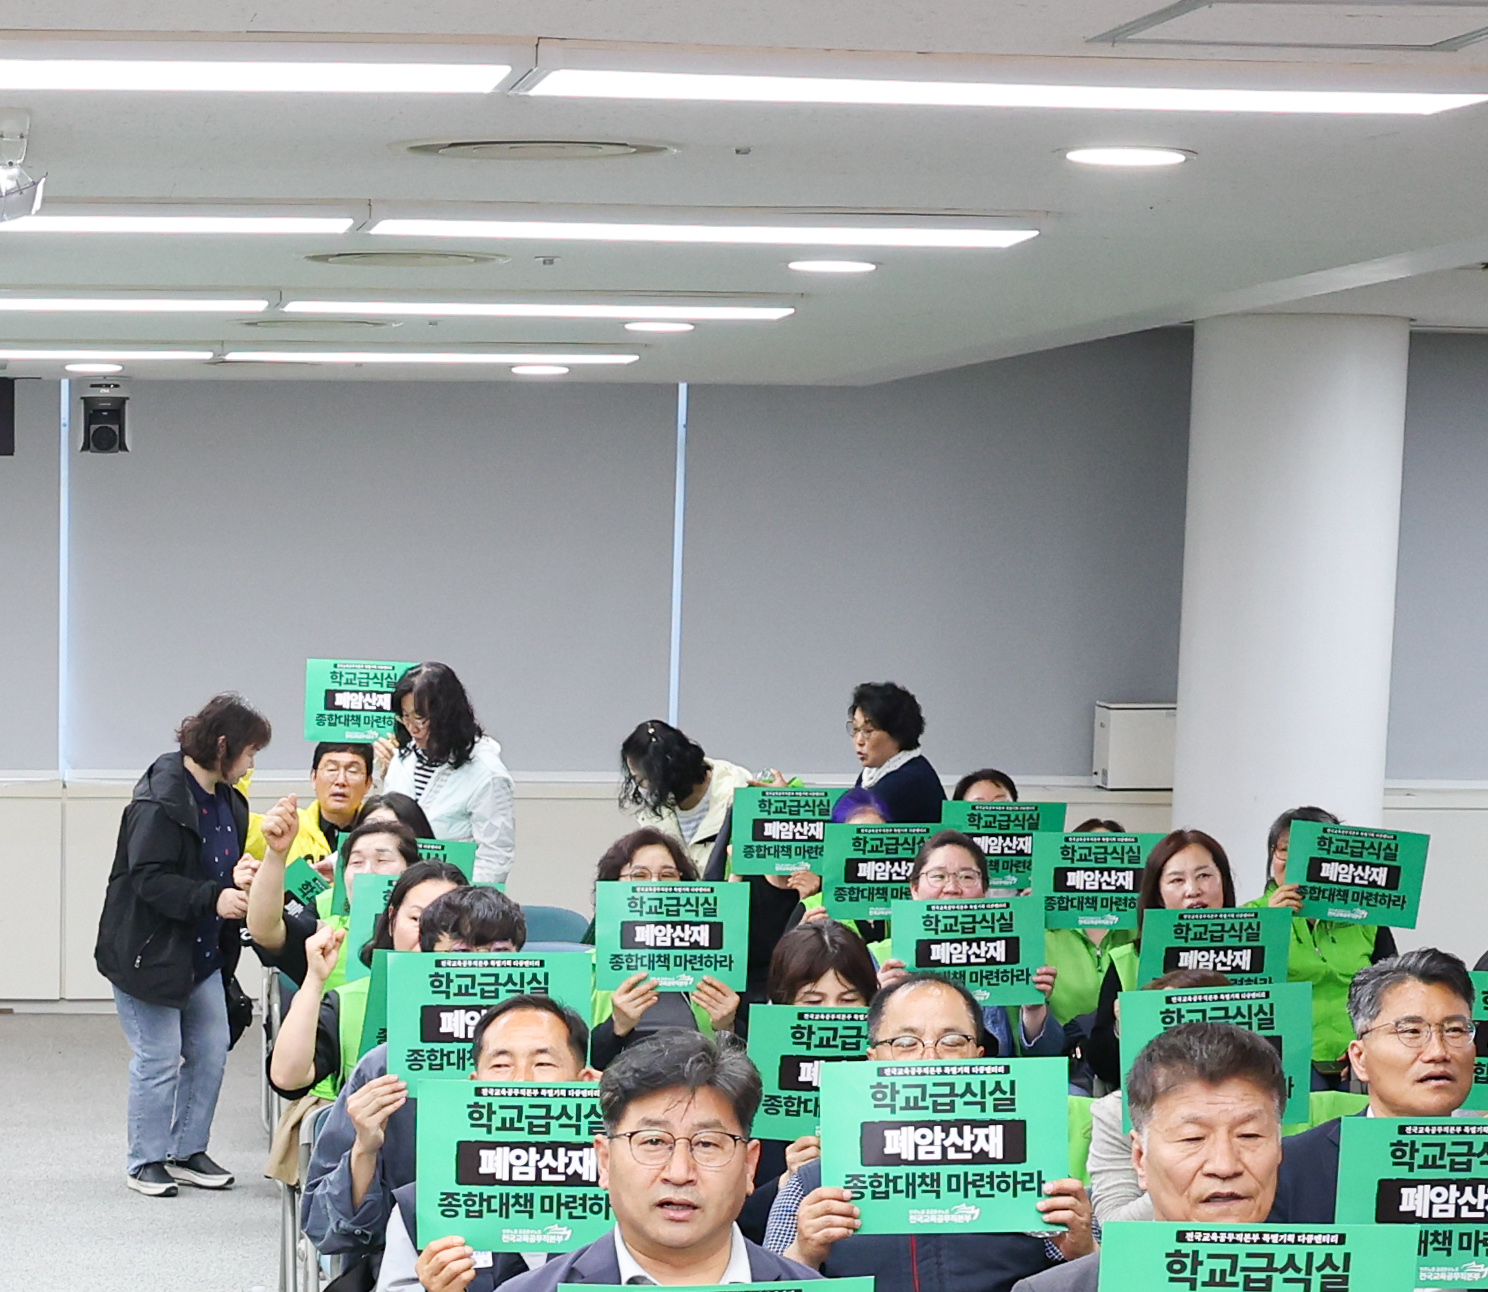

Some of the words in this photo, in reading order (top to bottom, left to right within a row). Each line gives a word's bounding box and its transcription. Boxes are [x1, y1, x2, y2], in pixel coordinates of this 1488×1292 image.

[329, 670, 397, 688] 학교급식실
[334, 691, 391, 710] 폐암산재
[314, 713, 361, 727] 종합대책
[757, 798, 830, 816] 학교급식실
[763, 821, 823, 839] 폐암산재
[966, 812, 1040, 830] 학교급식실
[741, 844, 792, 859] 종합대책
[1059, 844, 1141, 864] 학교급식실
[1316, 835, 1398, 861] 학교급식실
[1066, 870, 1133, 889] 폐암산재
[1320, 862, 1388, 886] 폐암산재
[832, 886, 888, 902] 종합대책
[1042, 895, 1097, 911] 종합대책
[1350, 890, 1406, 910] 마련하라
[626, 895, 717, 917] 학교급식실
[921, 911, 1013, 935] 학교급식실
[1173, 921, 1261, 943] 학교급식실
[635, 924, 709, 946] 폐암산재
[608, 953, 670, 971] 종합대책
[673, 953, 734, 971] 마련하라
[930, 939, 1005, 964] 폐암산재
[1178, 948, 1251, 971] 폐암산재
[428, 971, 549, 999] 학교급식실
[969, 967, 1031, 987] 마련하라
[869, 1079, 1016, 1114] 학교급식실
[884, 1124, 1003, 1160] 폐암산재
[479, 1146, 597, 1181] 폐암산재
[842, 1171, 940, 1200] 종합대책
[946, 1169, 1046, 1198] 마련하라
[436, 1191, 534, 1219] 종합대책
[539, 1192, 611, 1220] 마련하
[1261, 1233, 1295, 1243] 특별기획
[1164, 1249, 1352, 1292] 학교급식실
